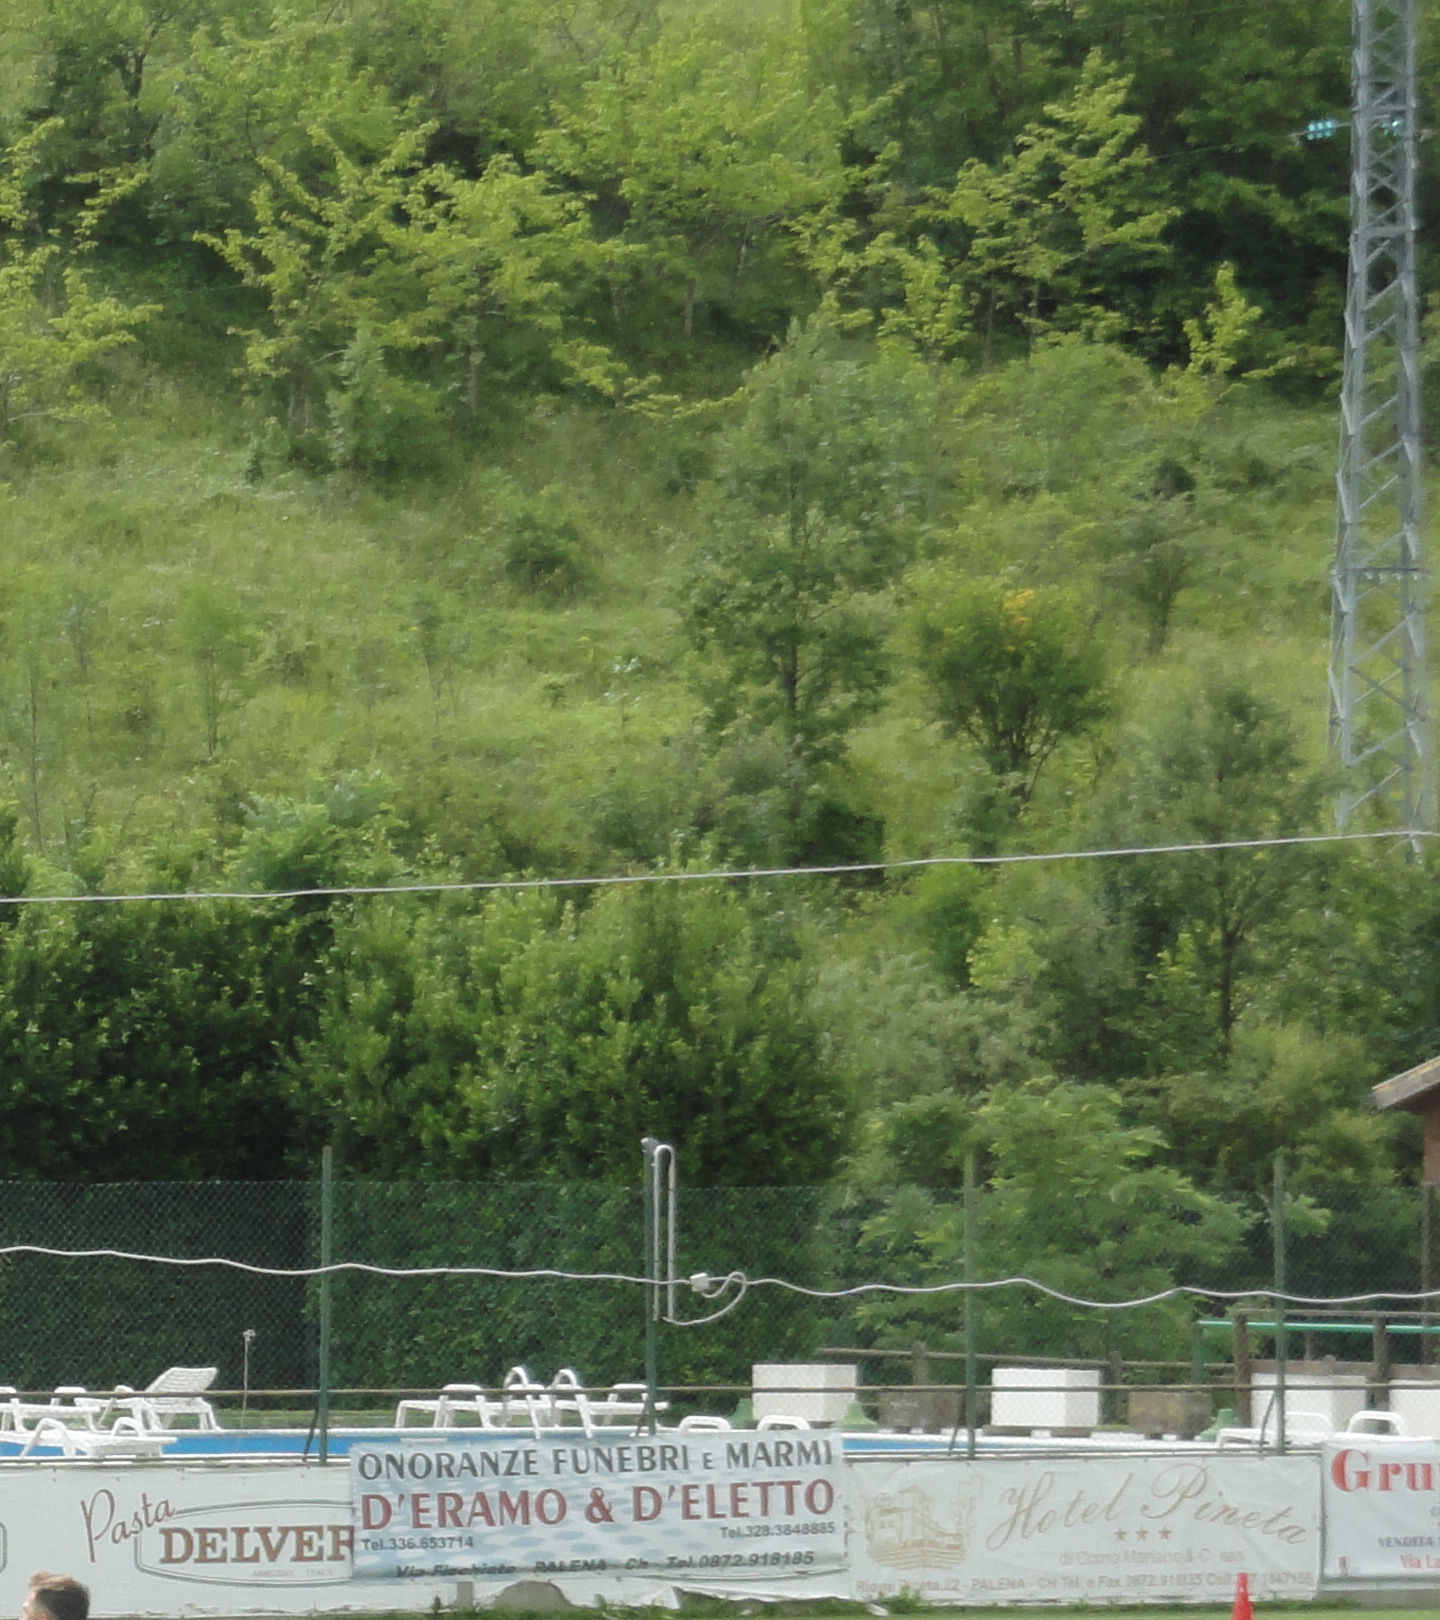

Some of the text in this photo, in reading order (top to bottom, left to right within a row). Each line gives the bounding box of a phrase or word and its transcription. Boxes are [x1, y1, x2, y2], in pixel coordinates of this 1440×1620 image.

[358, 1450, 539, 1480] ONORANZE
[552, 1444, 689, 1475] FUNEBRI
[726, 1440, 833, 1469] MARMI
[1331, 1448, 1440, 1493] Gru
[80, 1489, 177, 1563] Pasta
[361, 1478, 835, 1531] D'ERAMO & D'ELETTO
[986, 1463, 1308, 1551] Hotel Pineta
[535, 1559, 607, 1573] PALENA
